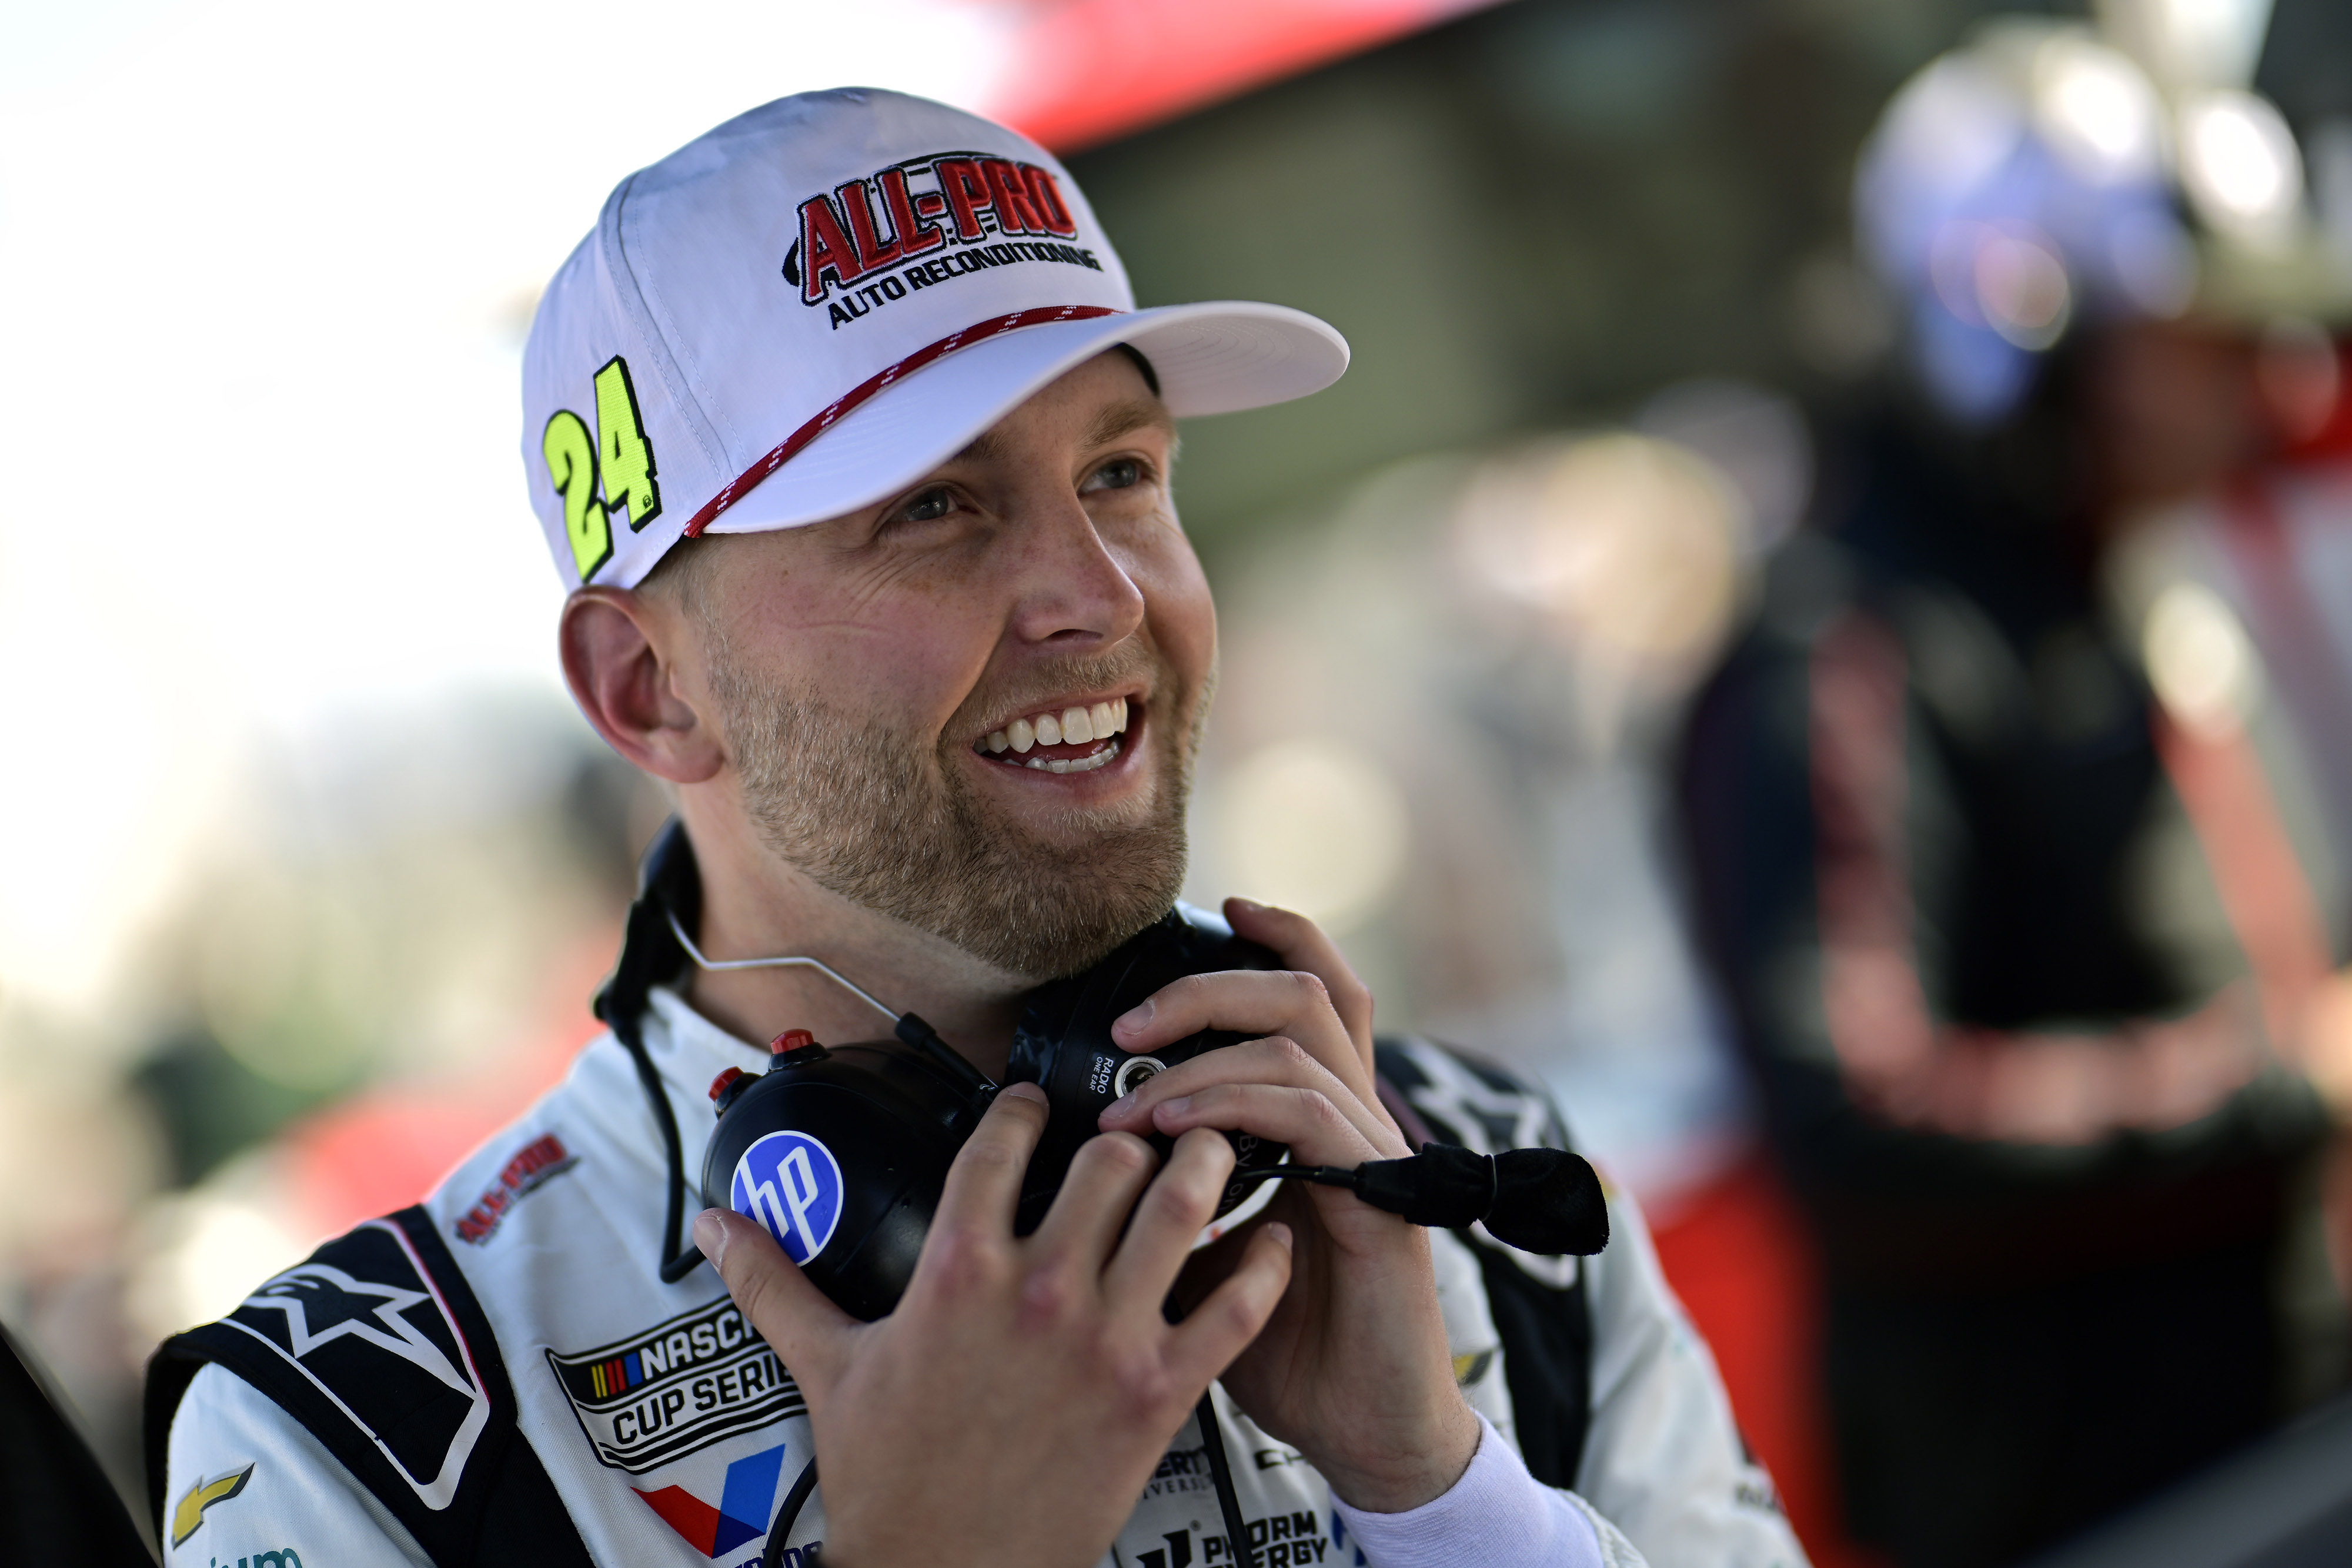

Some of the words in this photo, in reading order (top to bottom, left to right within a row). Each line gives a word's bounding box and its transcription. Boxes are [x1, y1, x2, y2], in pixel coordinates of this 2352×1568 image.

[796, 154, 1078, 306] ALL-PRO
[827, 273, 907, 330] AUTO
[902, 240, 1104, 293] RECONDITIONING
[542, 354, 663, 585] 24
[1088, 1074, 1099, 1091] EAR
[1093, 1056, 1104, 1074] ONE
[1097, 1057, 1114, 1095] RADIO
[737, 1145, 818, 1257] hp
[640, 1310, 755, 1379] NASC
[612, 1388, 685, 1445] CUP
